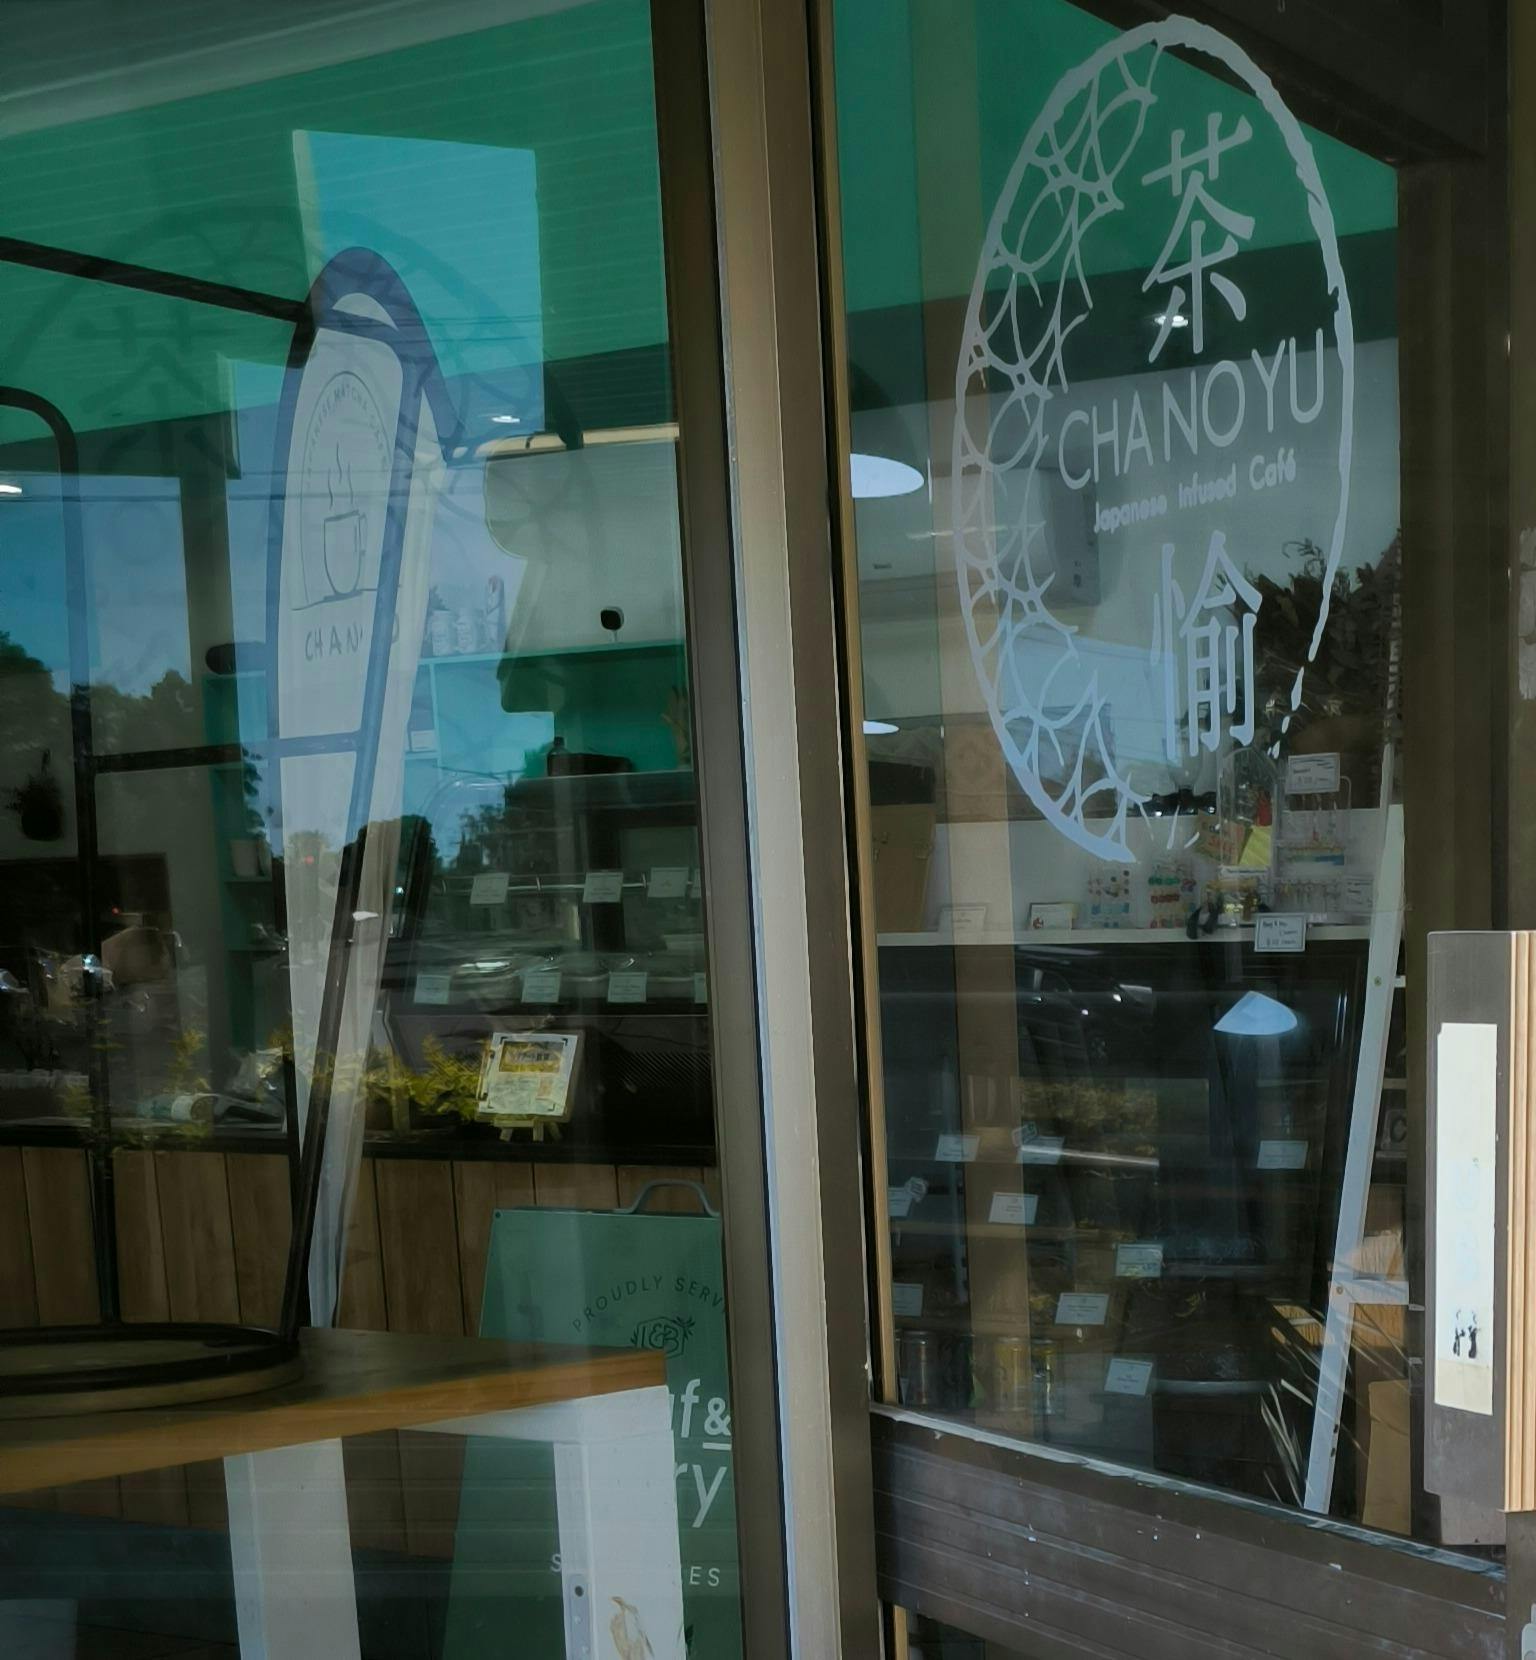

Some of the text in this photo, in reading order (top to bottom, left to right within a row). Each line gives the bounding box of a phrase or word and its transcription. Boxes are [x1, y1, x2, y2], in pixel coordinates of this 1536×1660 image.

[1141, 112, 1256, 363] 茶
[1058, 327, 1324, 490] CHANOYU
[1094, 446, 1297, 535] Japanese Infused Café
[1151, 529, 1263, 768] 愉
[572, 1275, 724, 1333] PROUDLY SERV
